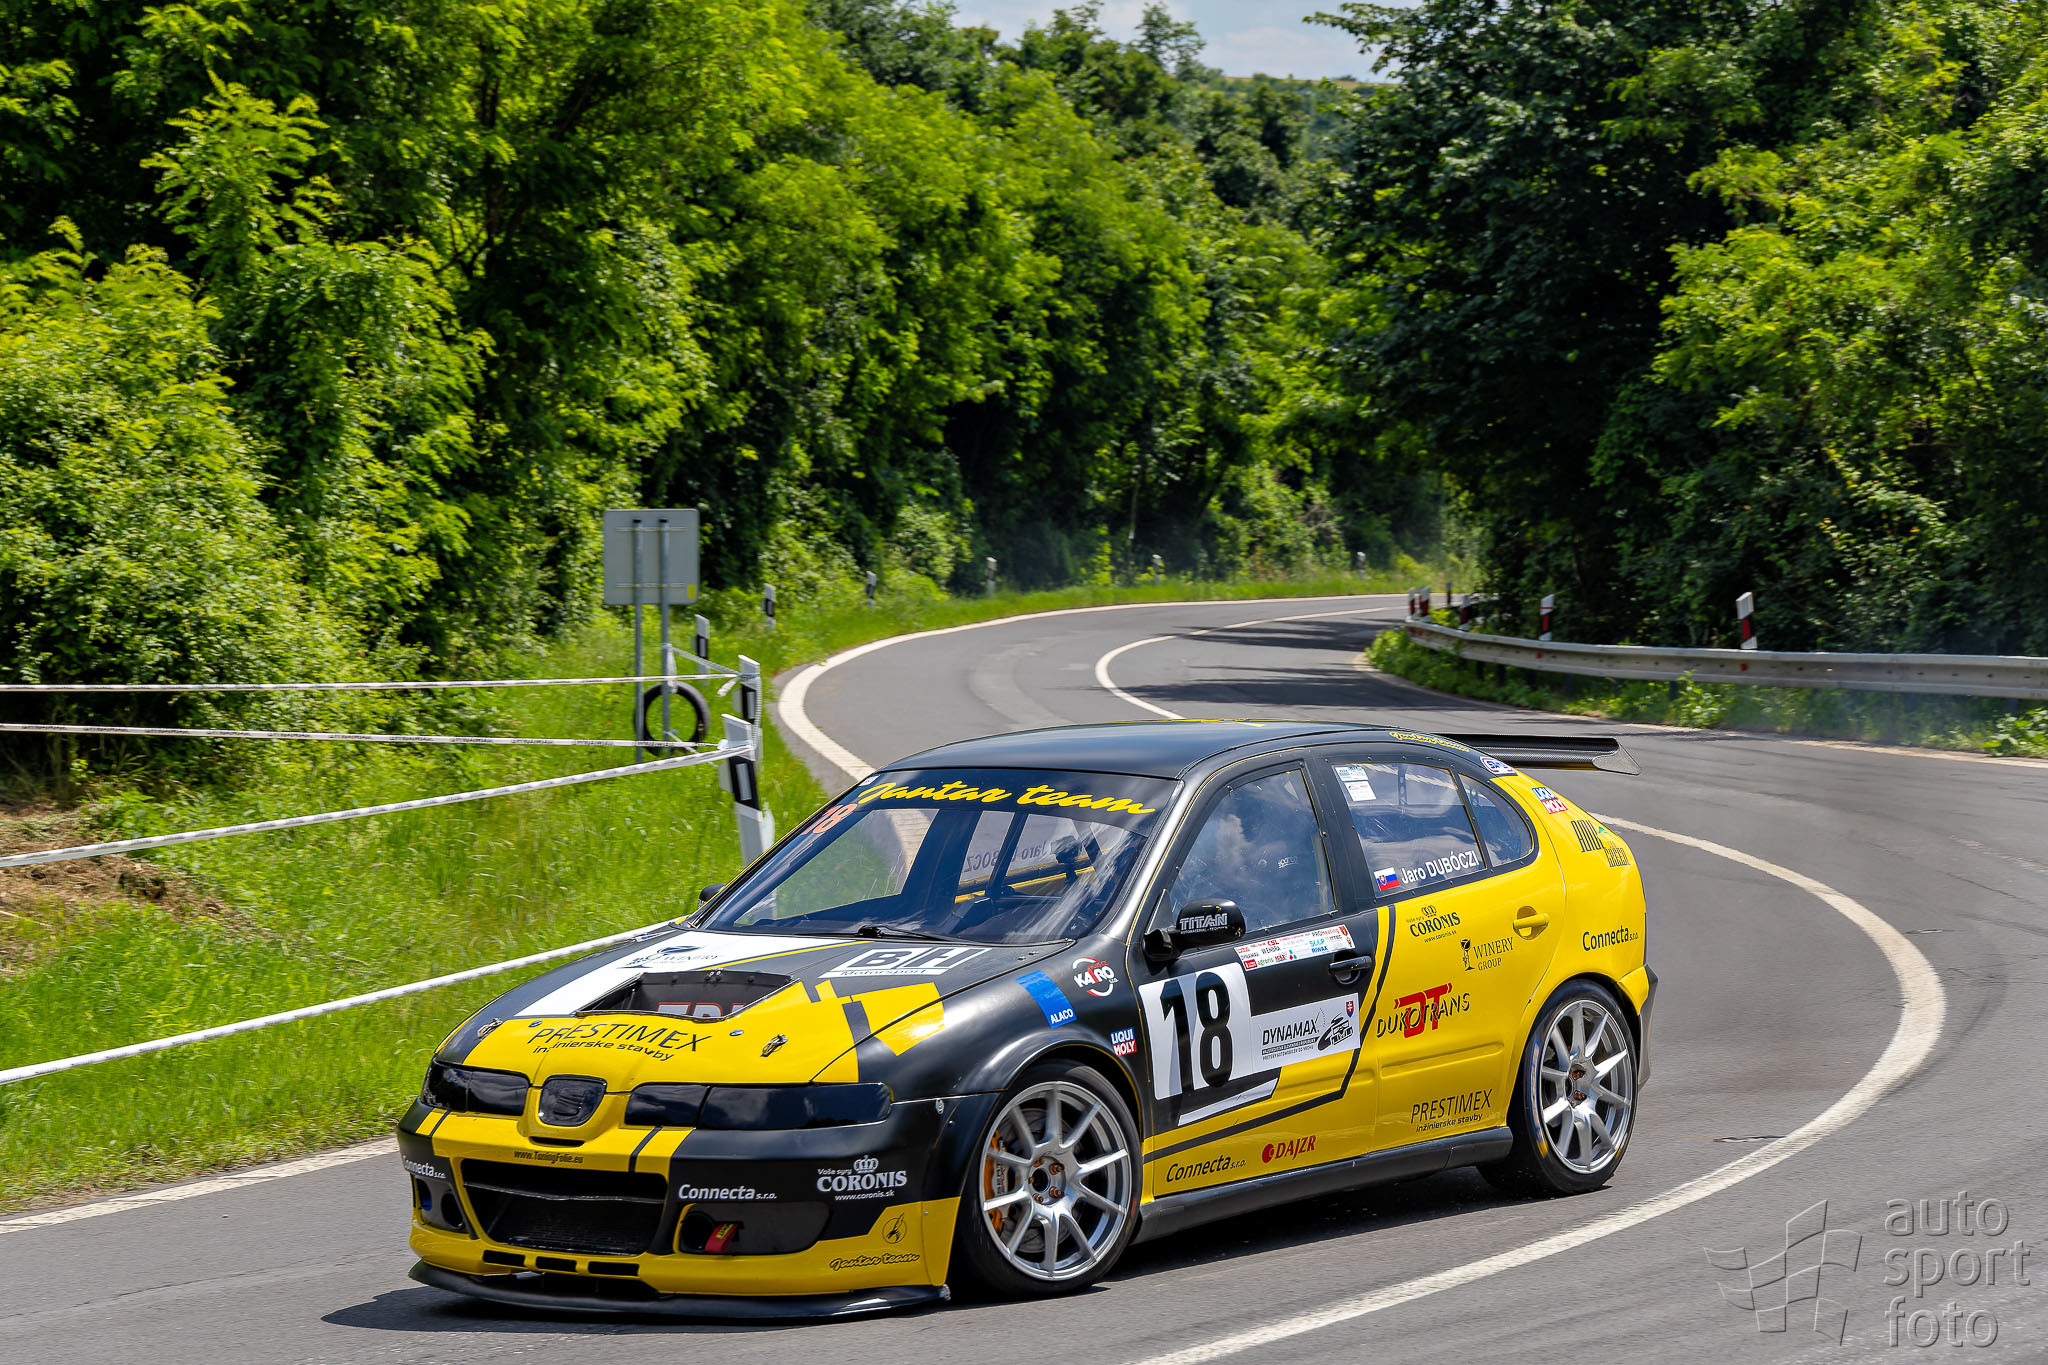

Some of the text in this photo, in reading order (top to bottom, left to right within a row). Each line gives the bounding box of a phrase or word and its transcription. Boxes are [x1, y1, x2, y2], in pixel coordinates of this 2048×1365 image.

[858, 781, 1155, 814] Jantar team
[800, 803, 857, 836] 18
[1401, 850, 1479, 884] Jaro DUBÓCZI
[1180, 913, 1228, 931] TITAN
[1410, 912, 1461, 938] CORONIS
[1473, 937, 1514, 960] WINERY
[1583, 924, 1629, 951] Connecta
[1477, 957, 1502, 971] GROUP
[1073, 966, 1114, 988] KARO
[1050, 1008, 1074, 1024] ALACO
[1376, 992, 1470, 1039] DUKOTRANS
[527, 1024, 713, 1052] PRESTIMEX
[1111, 1028, 1134, 1045] LIQUI
[1160, 972, 1233, 1092] 18
[618, 1043, 674, 1062] stavby
[1113, 1041, 1136, 1056] MOLY
[1410, 1088, 1493, 1124] PRESTIMEX
[1457, 1112, 1483, 1124] stavby
[513, 1150, 584, 1164] www.TuningFolie.eu
[1275, 1135, 1317, 1160] DAJZR
[1166, 1154, 1246, 1183] Connecta s.r.o.
[678, 1183, 778, 1200] Connecta s.r.o.
[816, 1170, 908, 1192] CORONIS
[834, 1189, 895, 1201] www.coronis.sk
[829, 1252, 920, 1271] Jantar team
